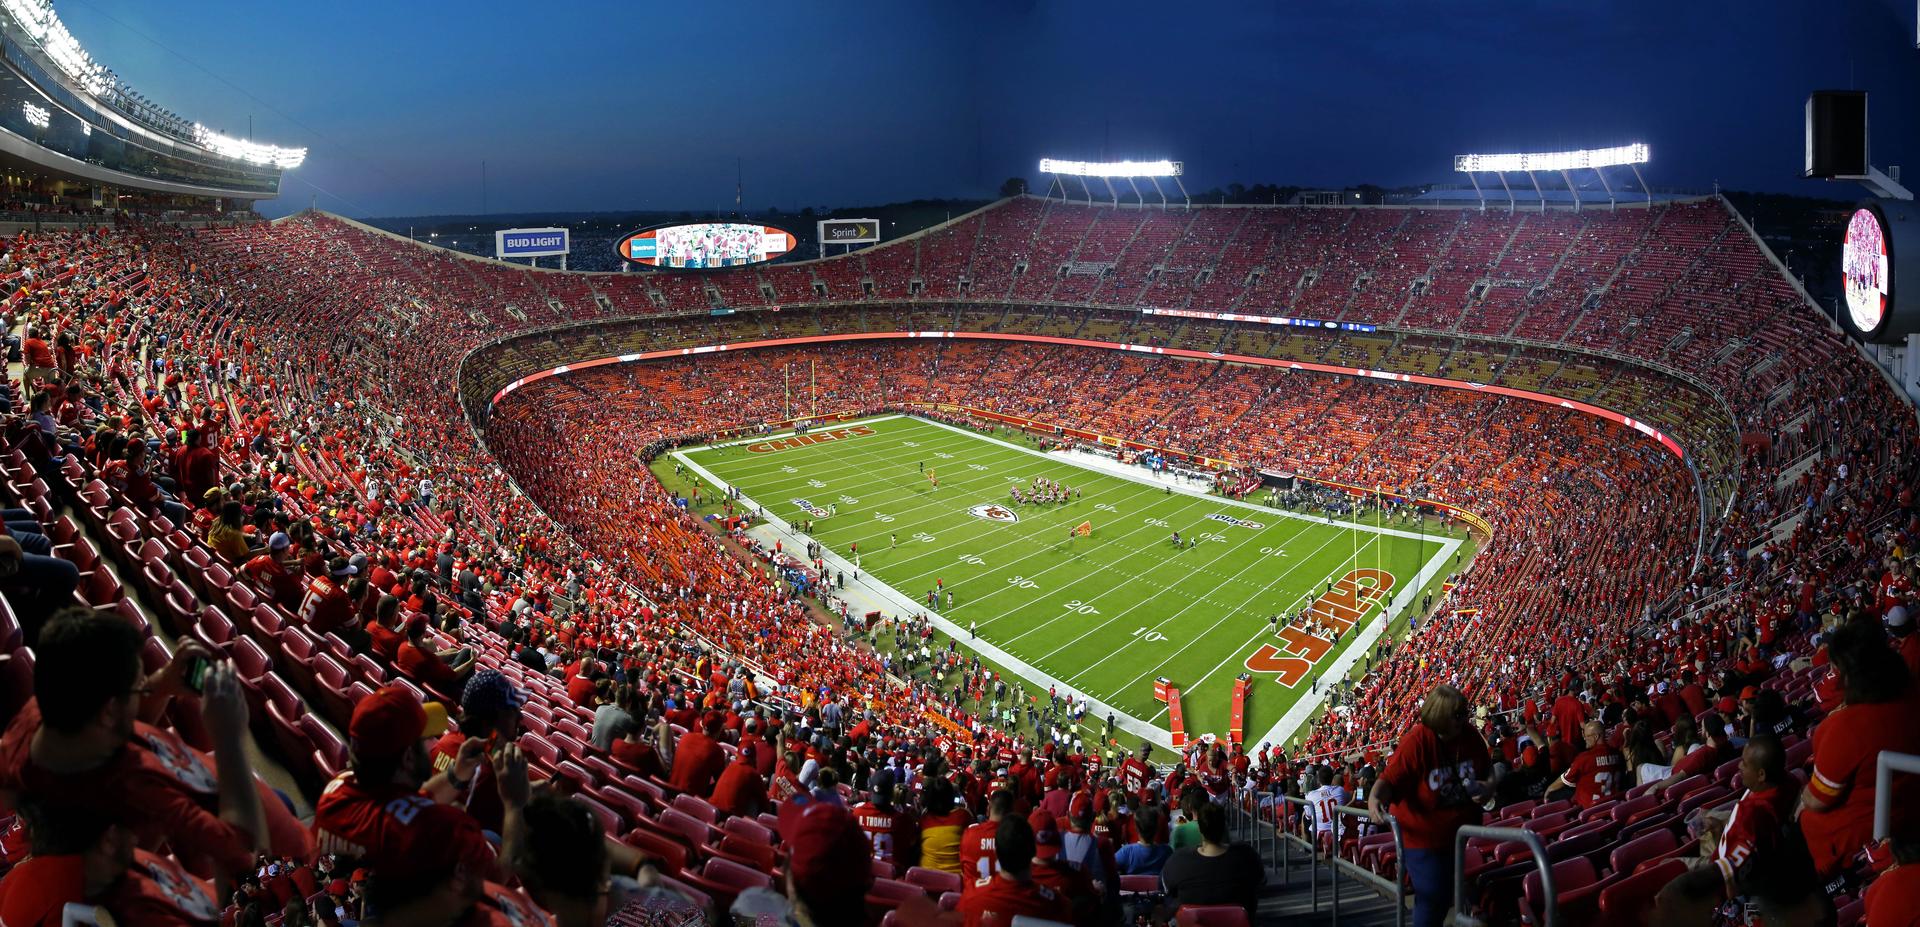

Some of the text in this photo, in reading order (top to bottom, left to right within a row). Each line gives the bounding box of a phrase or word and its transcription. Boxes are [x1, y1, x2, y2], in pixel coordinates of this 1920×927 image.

[832, 228, 857, 239] Sprint
[507, 237, 561, 248] BUD LIGHT
[746, 426, 877, 453] CHIEFS
[912, 532, 936, 543] 50
[958, 554, 982, 565] 40
[1008, 575, 1034, 589] 30
[1063, 600, 1092, 615] 20
[1131, 627, 1161, 642] 10
[1244, 568, 1396, 689] CHIEFS
[866, 816, 892, 828] THOMAS
